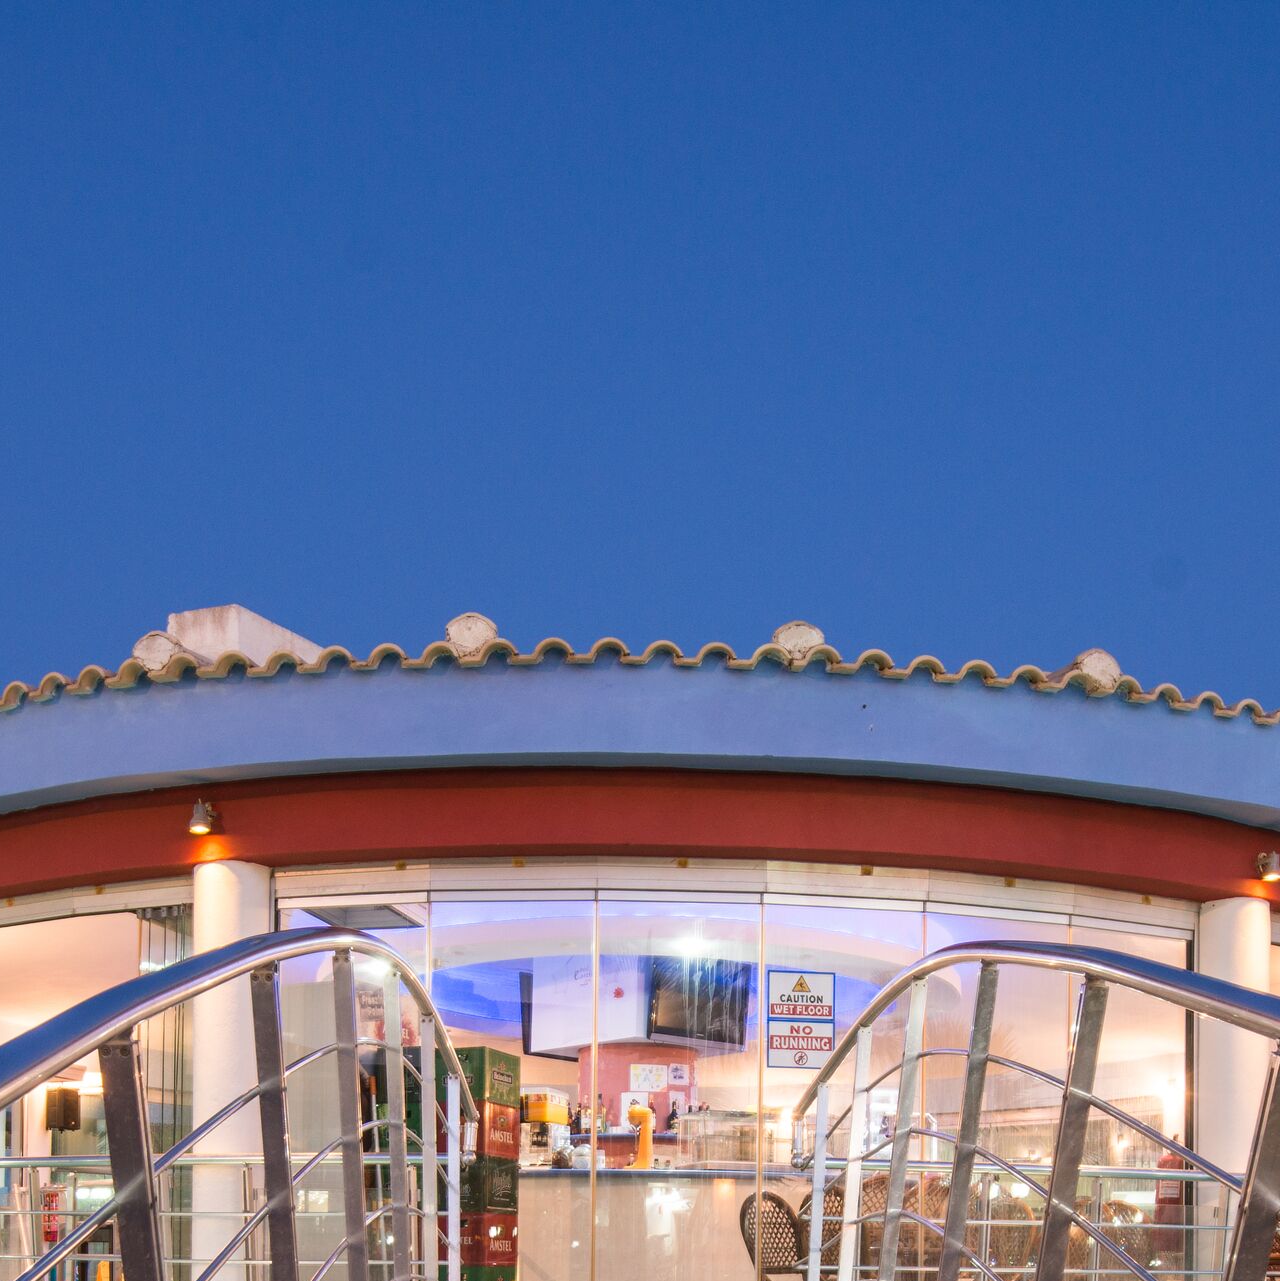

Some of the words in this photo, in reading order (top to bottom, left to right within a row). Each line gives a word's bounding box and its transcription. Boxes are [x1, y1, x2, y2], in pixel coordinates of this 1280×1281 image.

[780, 994, 824, 1004] CAUTION
[773, 1004, 795, 1014] WET
[796, 1006, 830, 1015] FLOOR
[789, 1025, 813, 1035] NO
[773, 1036, 830, 1050] RUNNING
[490, 1127, 514, 1144] AMSTEL
[489, 1238, 512, 1251] AMSTEL
